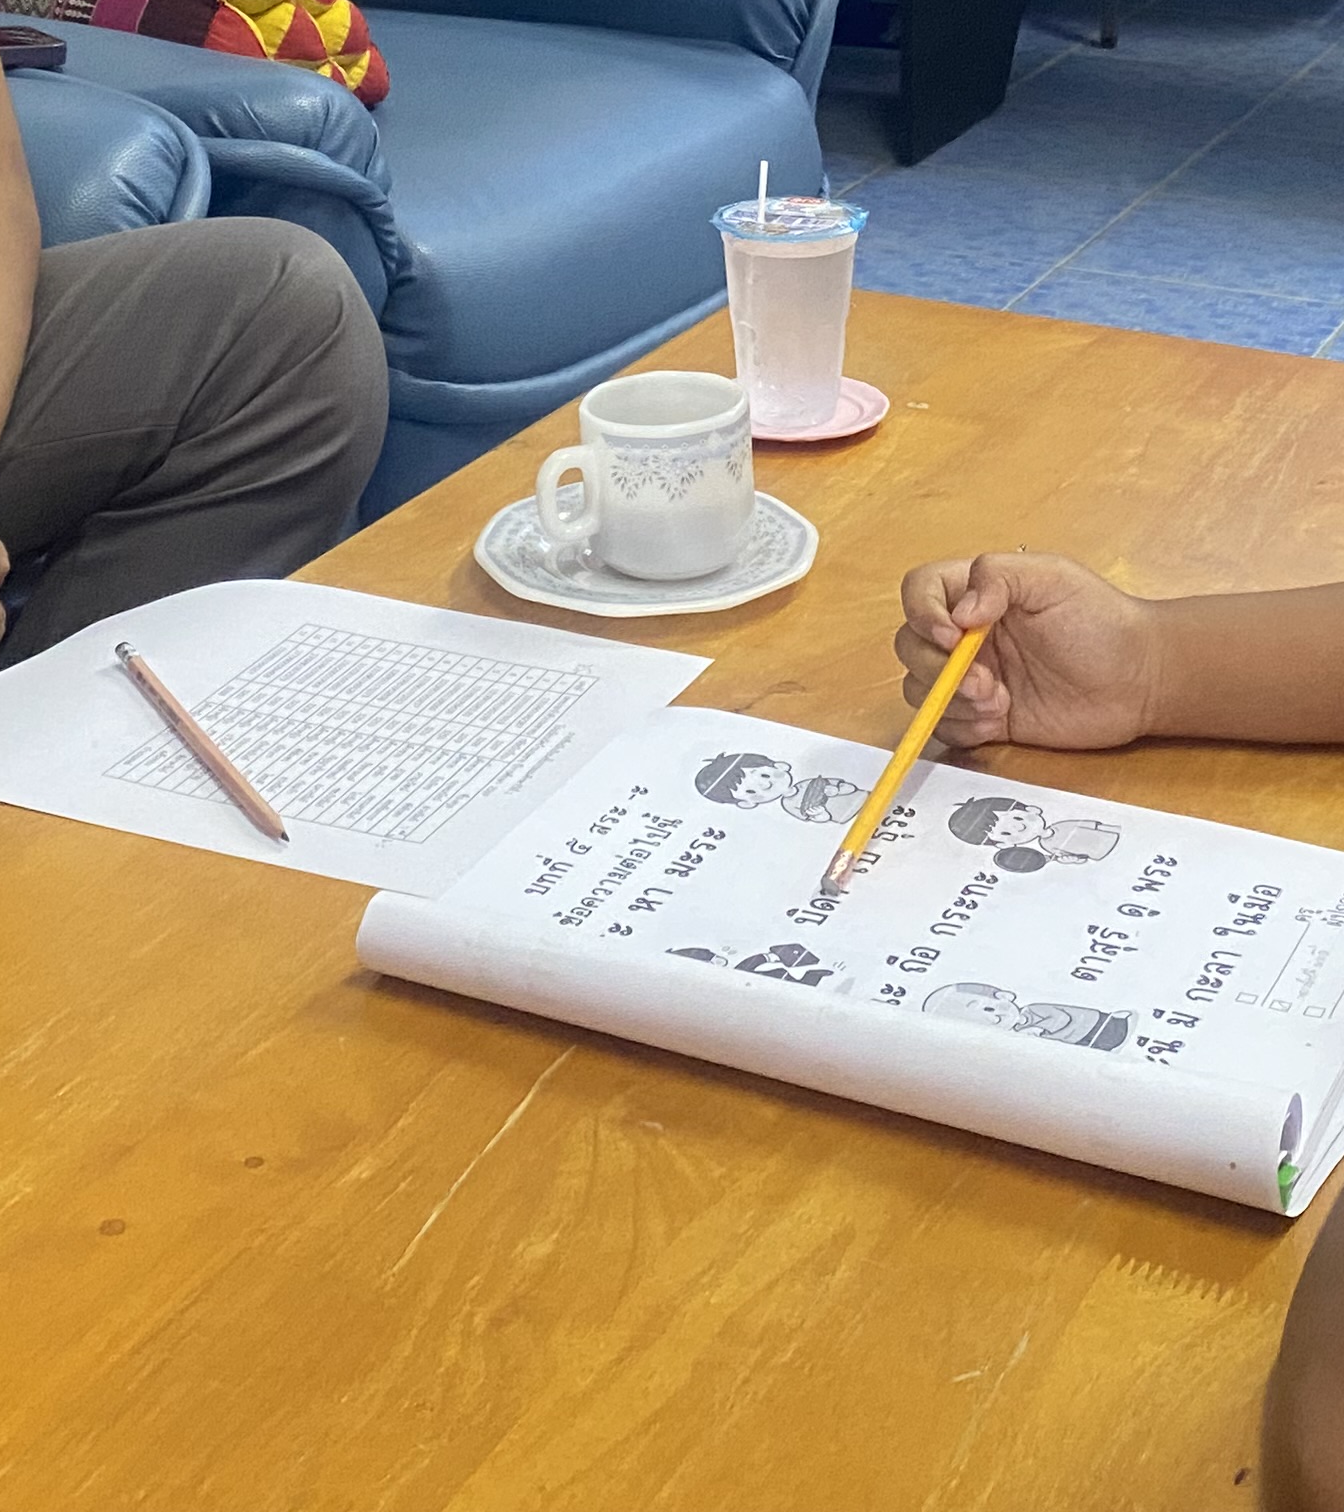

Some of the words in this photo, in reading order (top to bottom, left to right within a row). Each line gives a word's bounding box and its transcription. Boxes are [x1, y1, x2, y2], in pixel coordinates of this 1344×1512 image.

[664, 827, 726, 878] มะระ
[1132, 854, 1178, 892] พระ
[886, 946, 941, 973] ถือ
[930, 871, 999, 936] กระทะ
[1212, 884, 1281, 936] ในมือ
[1185, 951, 1241, 1002] กะลา
